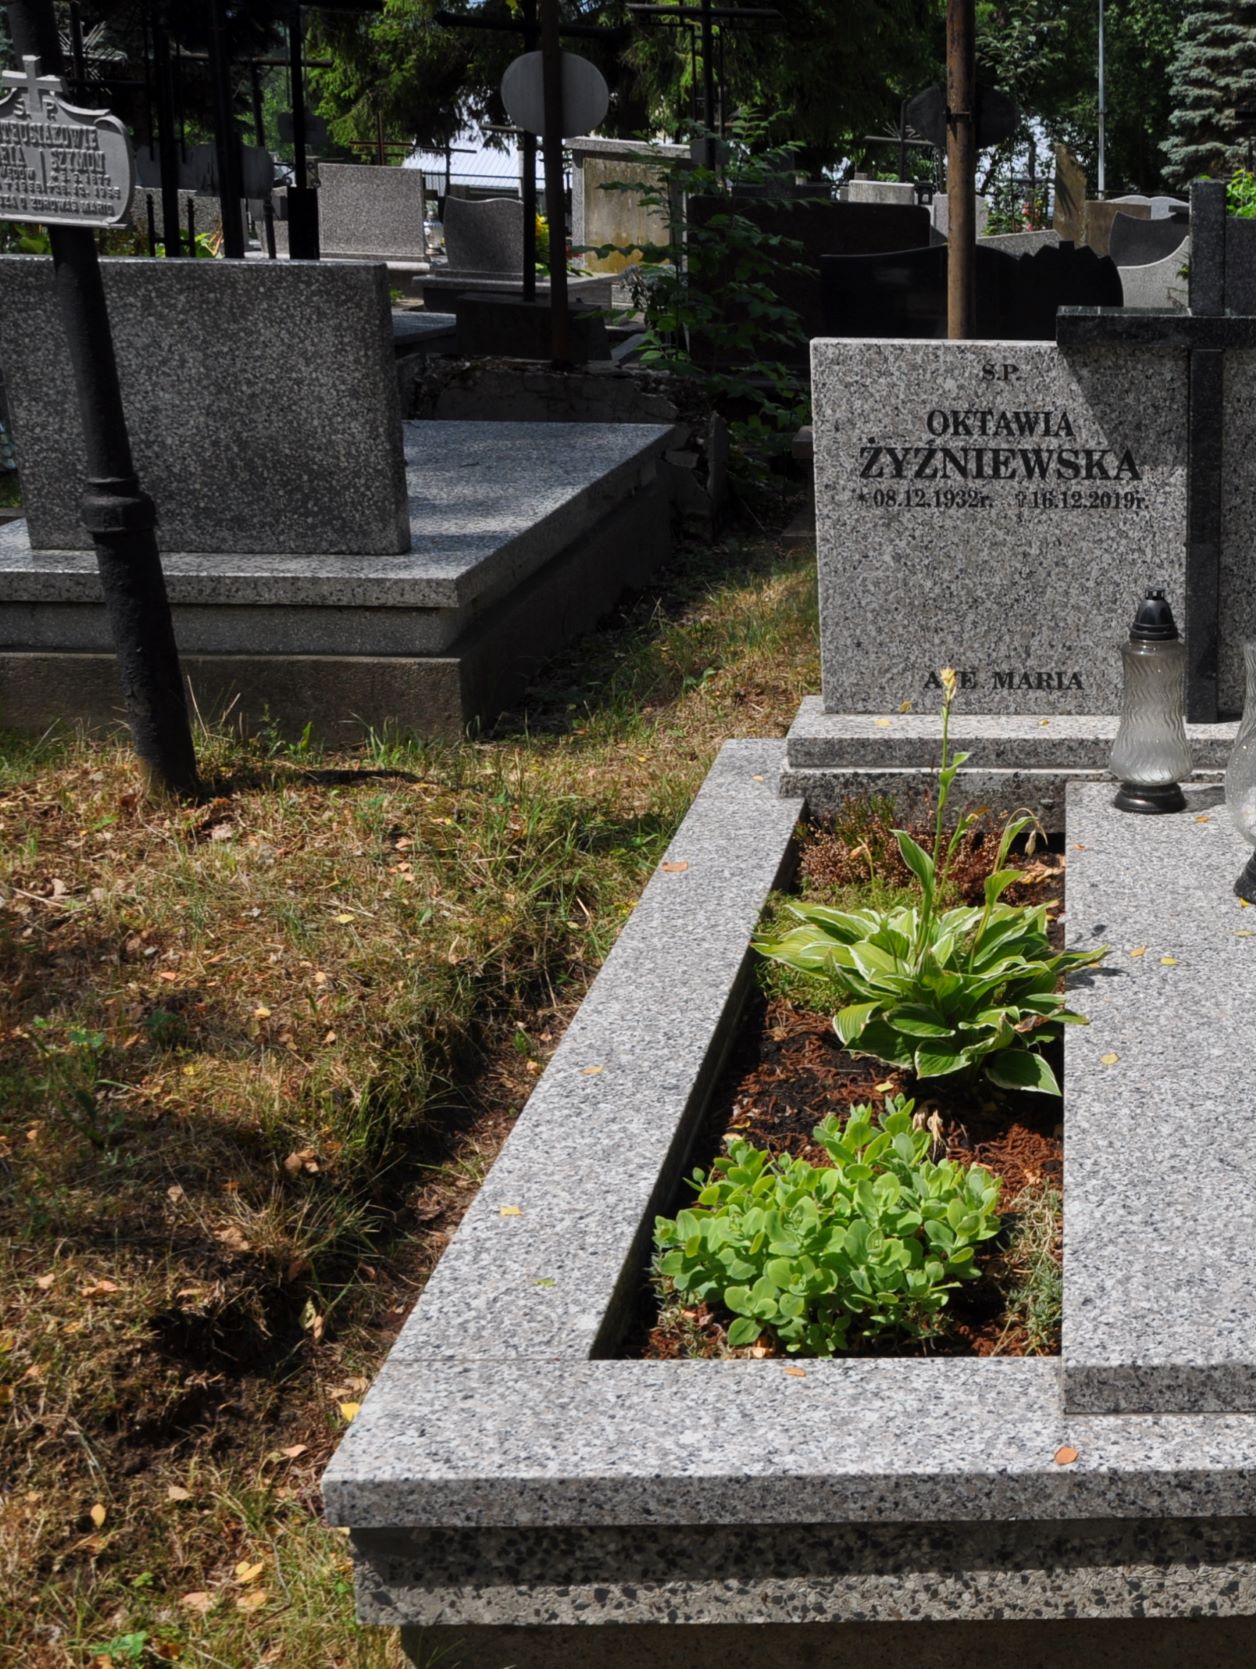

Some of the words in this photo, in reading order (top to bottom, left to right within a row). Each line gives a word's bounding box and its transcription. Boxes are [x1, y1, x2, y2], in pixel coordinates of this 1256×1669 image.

[926, 410, 1075, 437] OKTAWIA
[859, 437, 1143, 480] ŻYŹNIEWSKA
[923, 670, 977, 690] AE
[991, 671, 1085, 690] MARIA
